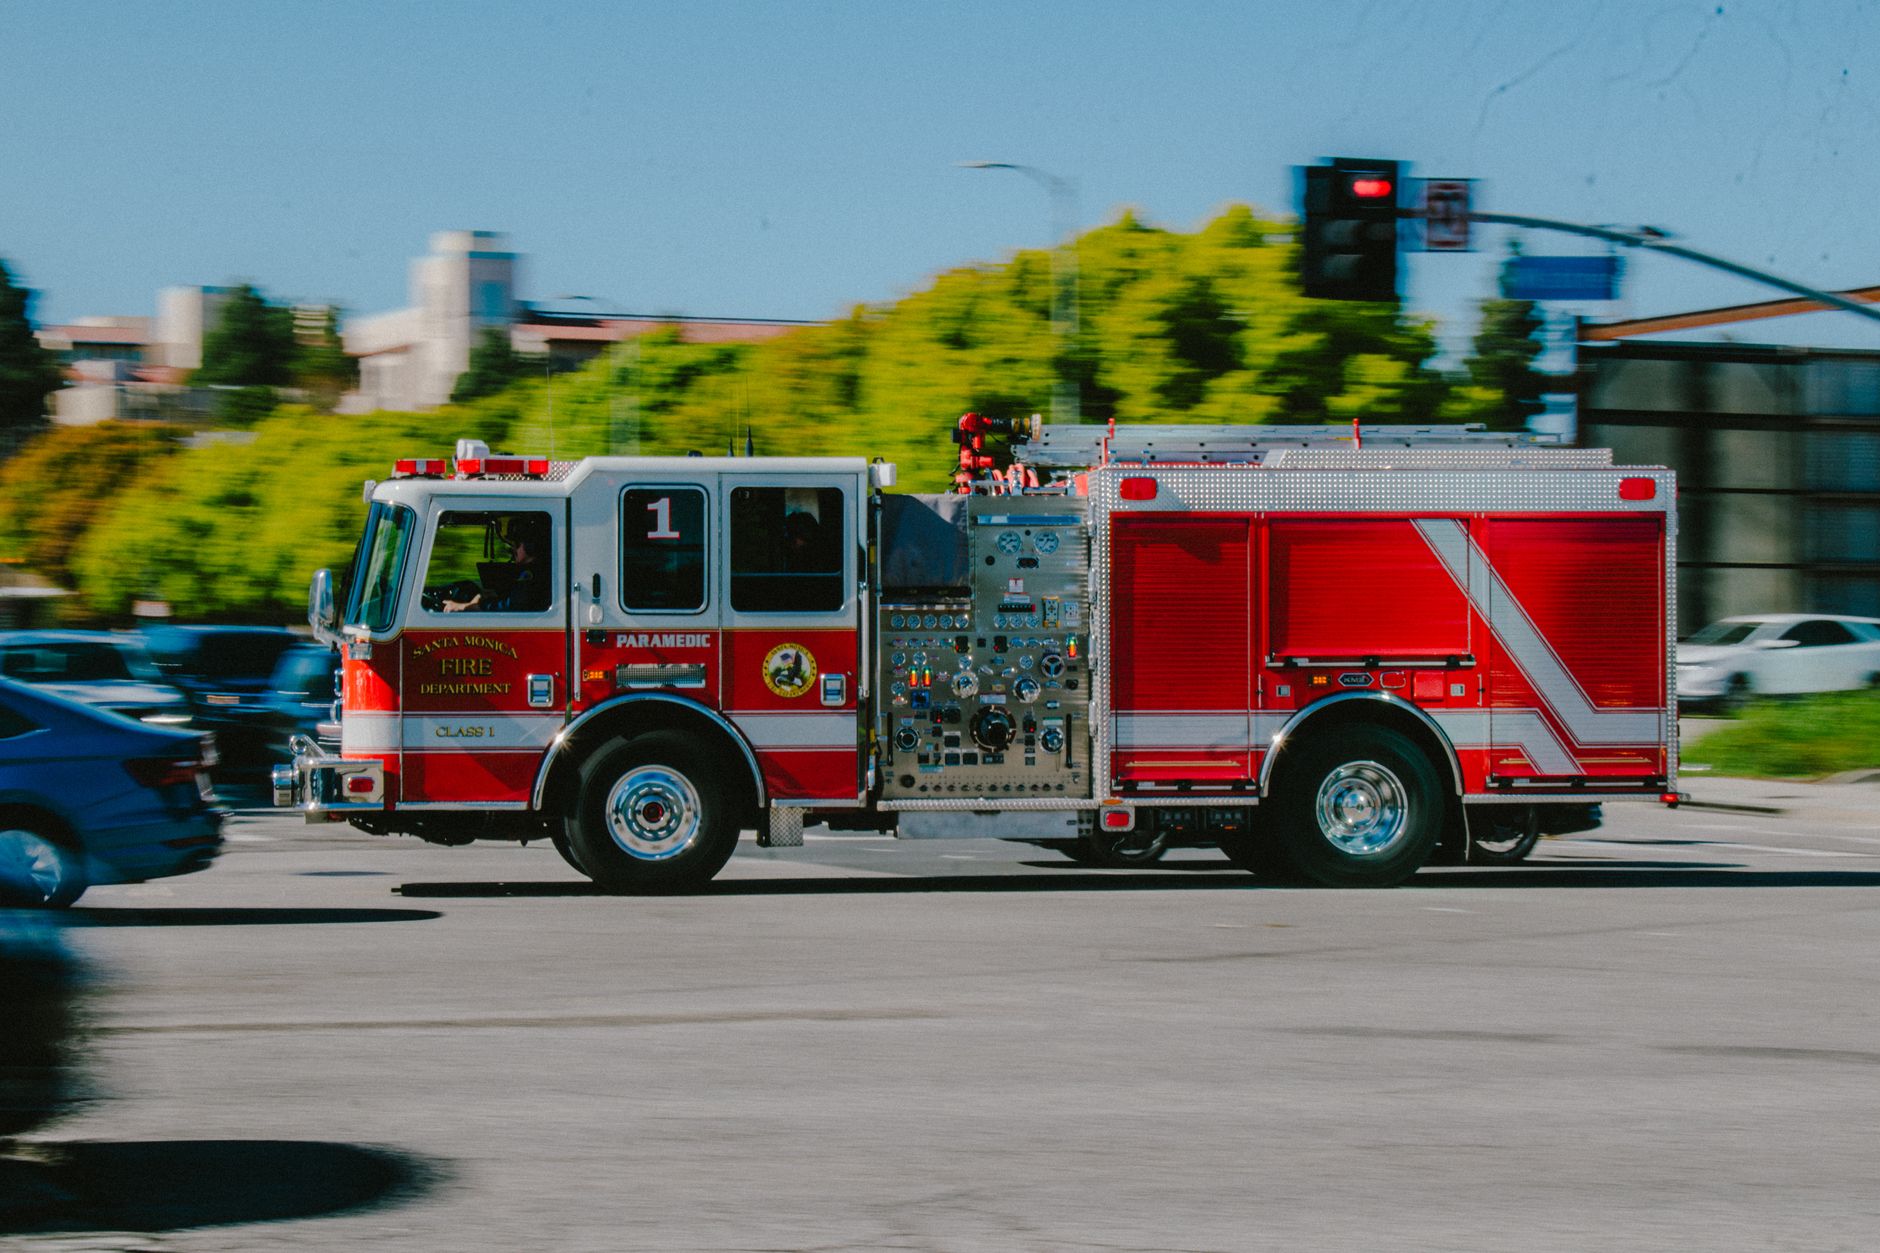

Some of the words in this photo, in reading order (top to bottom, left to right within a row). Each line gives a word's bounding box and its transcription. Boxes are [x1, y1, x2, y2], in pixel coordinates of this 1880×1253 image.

[647, 497, 680, 539] 1
[412, 637, 459, 659] SANTA
[464, 635, 518, 659] MONICA
[616, 633, 711, 648] PARAMEDIC
[441, 658, 493, 676] FIRE
[420, 683, 511, 694] DEPARTMENT
[435, 726, 485, 737] CLASS
